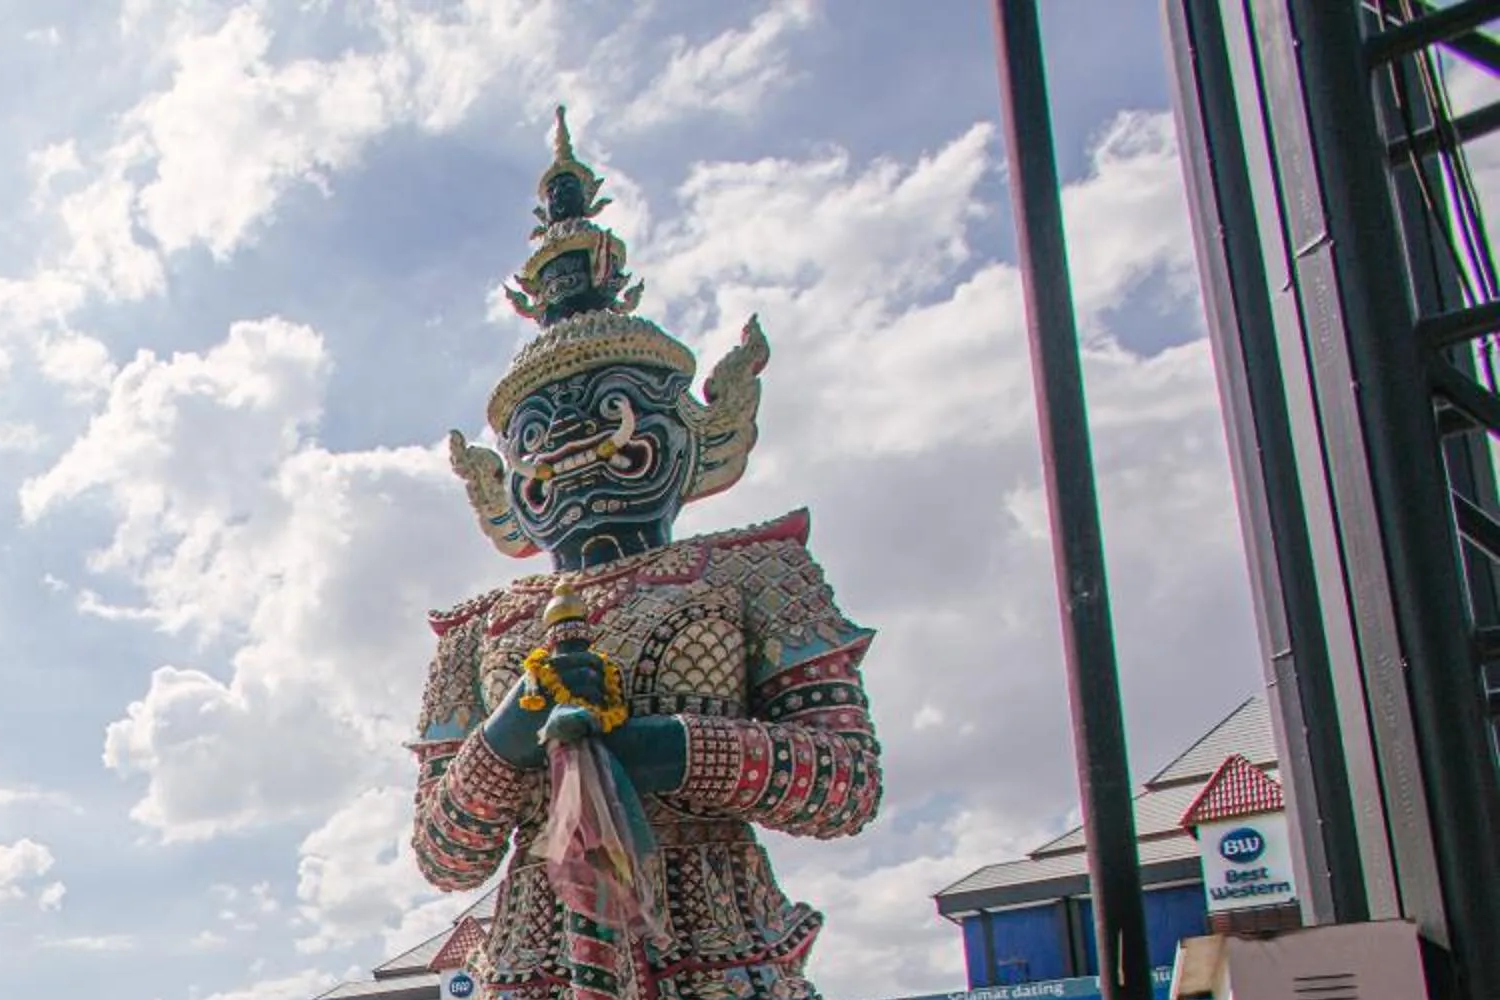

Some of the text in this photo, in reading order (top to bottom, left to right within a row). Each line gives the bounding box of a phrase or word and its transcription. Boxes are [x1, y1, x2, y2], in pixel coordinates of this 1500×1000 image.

[1223, 836, 1260, 855] BW
[1226, 867, 1269, 883] Best
[1210, 882, 1291, 900] Western
